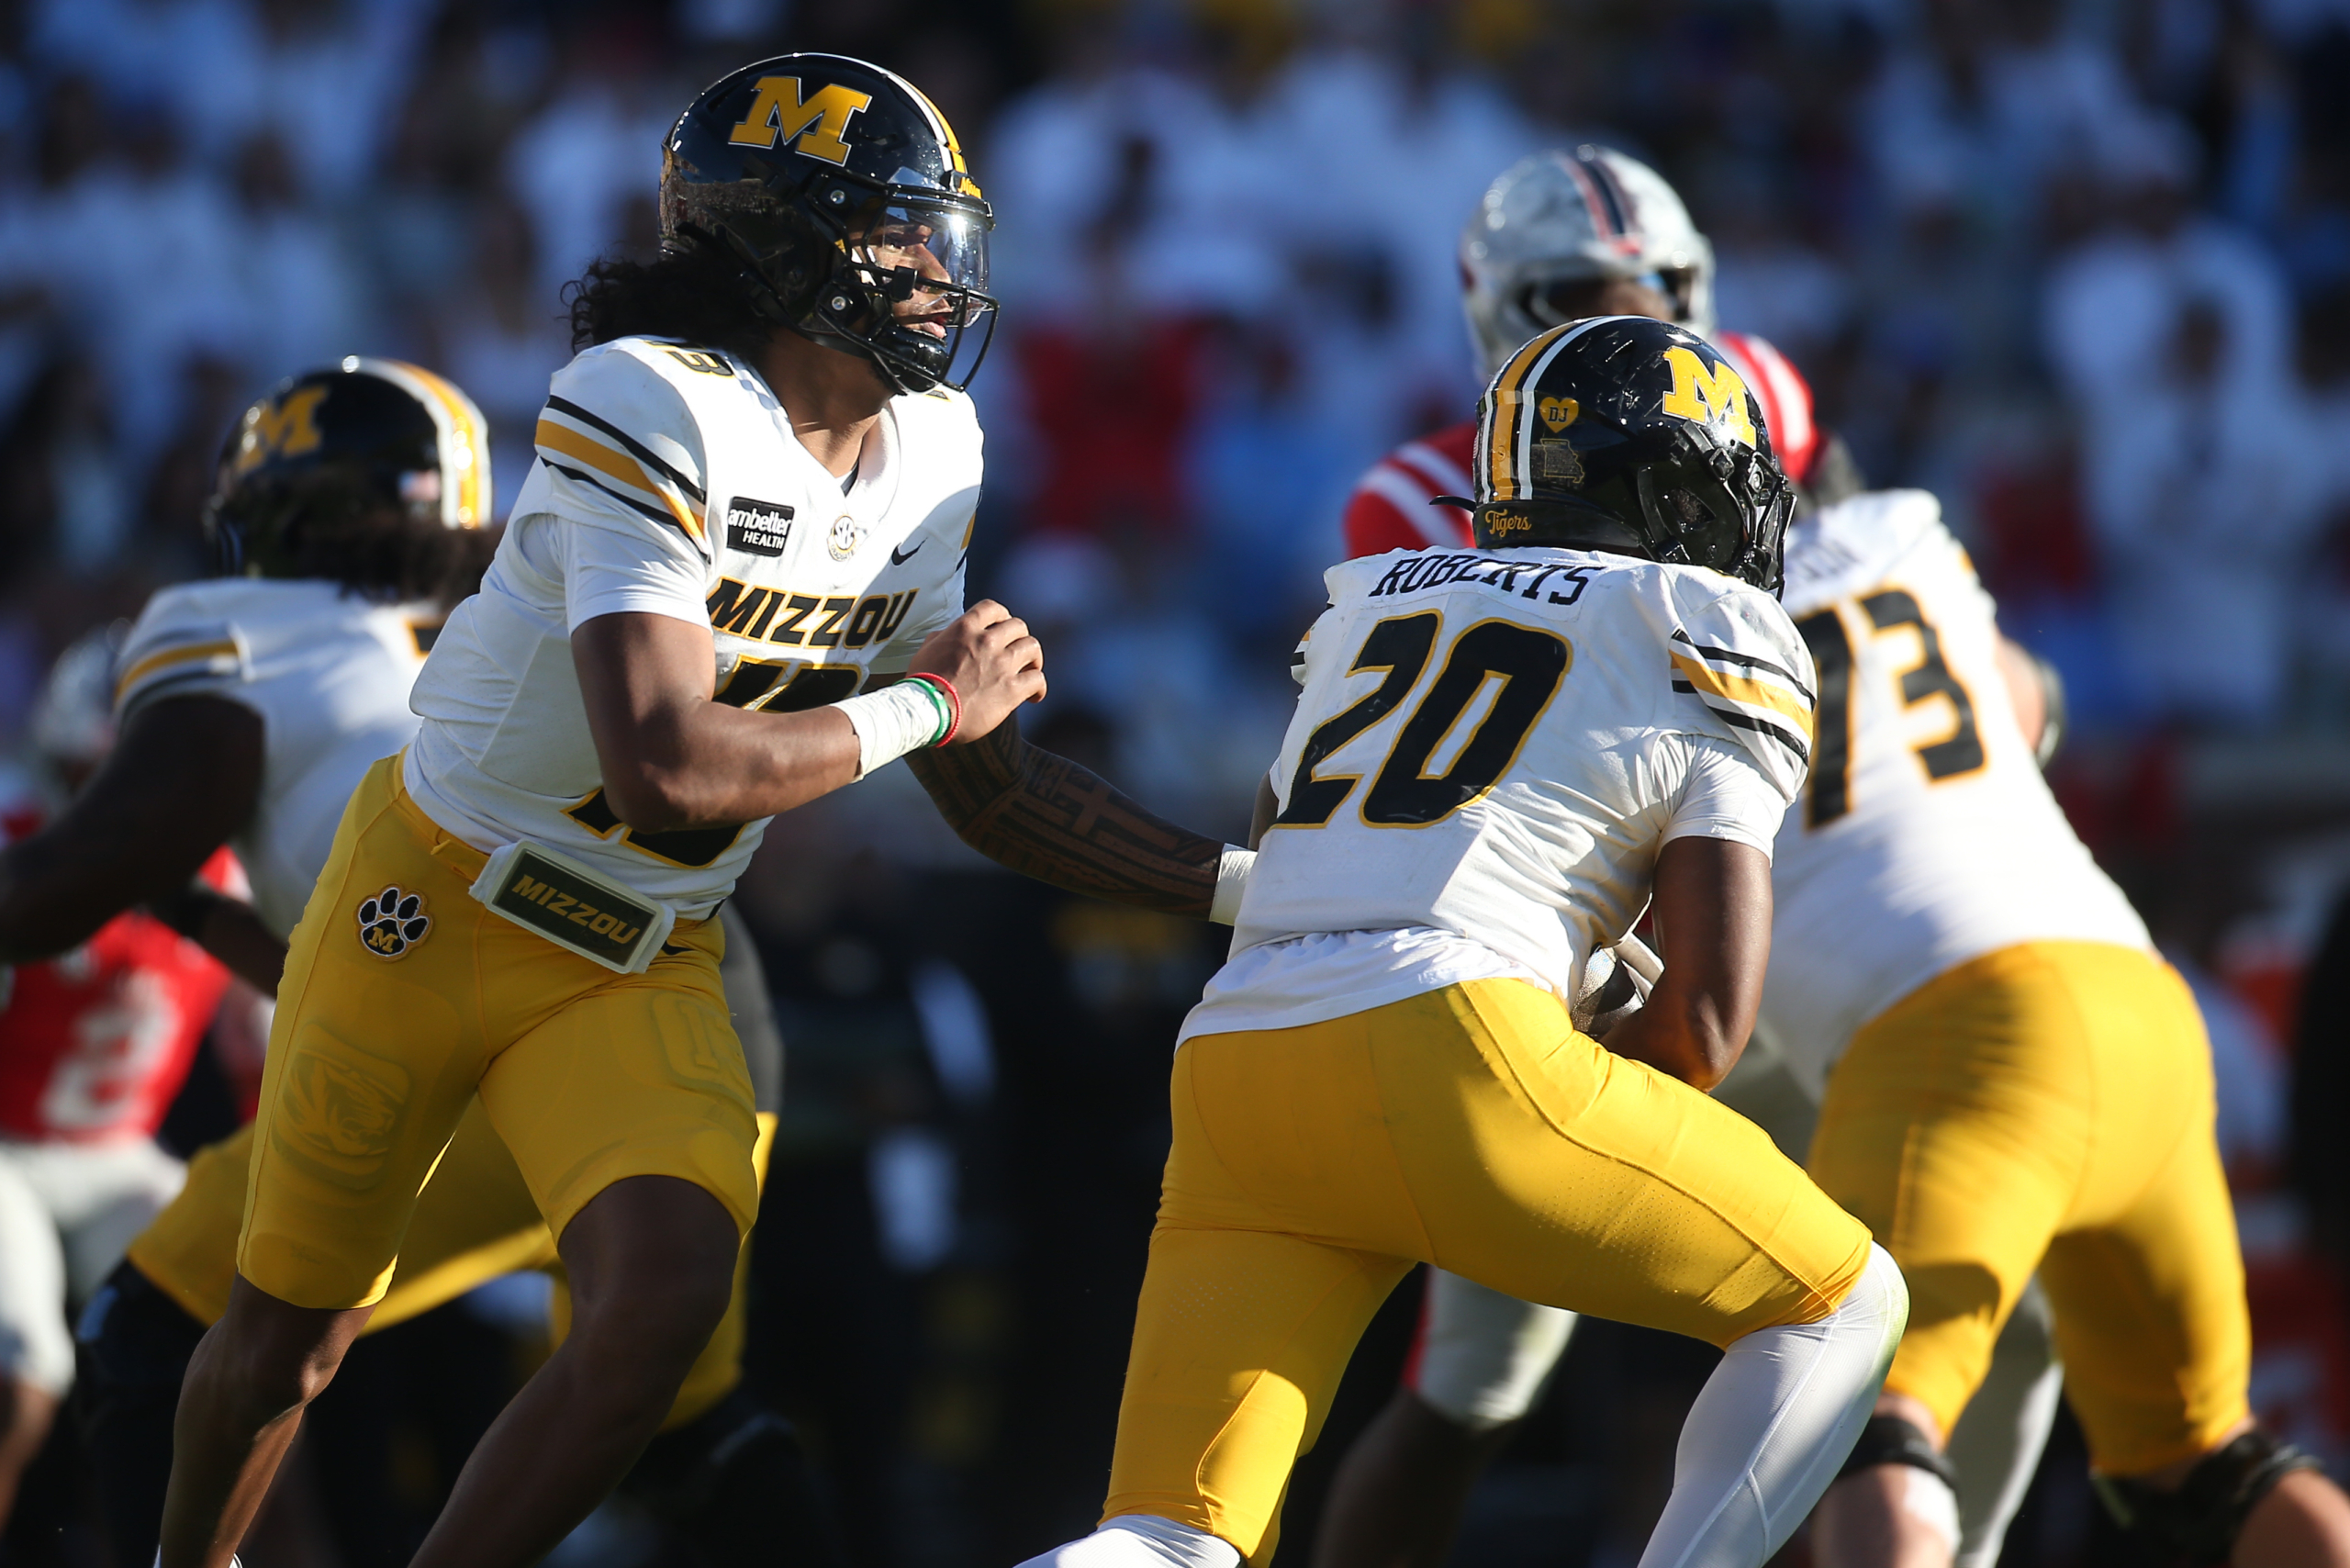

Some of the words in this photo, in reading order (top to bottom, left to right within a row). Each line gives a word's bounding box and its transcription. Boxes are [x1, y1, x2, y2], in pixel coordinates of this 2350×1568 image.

[729, 76, 872, 166] M
[1548, 406, 1569, 422] DJ
[1662, 345, 1757, 450] M
[235, 385, 329, 474] M
[728, 508, 792, 536] ambetter
[742, 530, 785, 549] HEALTH
[834, 517, 855, 549] SEC
[1485, 510, 1532, 538] Tigers
[1369, 554, 1607, 606] ROBERTS
[706, 576, 920, 650] MIZZOU
[1263, 608, 1573, 830] 20
[1796, 577, 1991, 835] 73
[367, 926, 398, 953] M
[510, 873, 640, 946] MIZZOU
